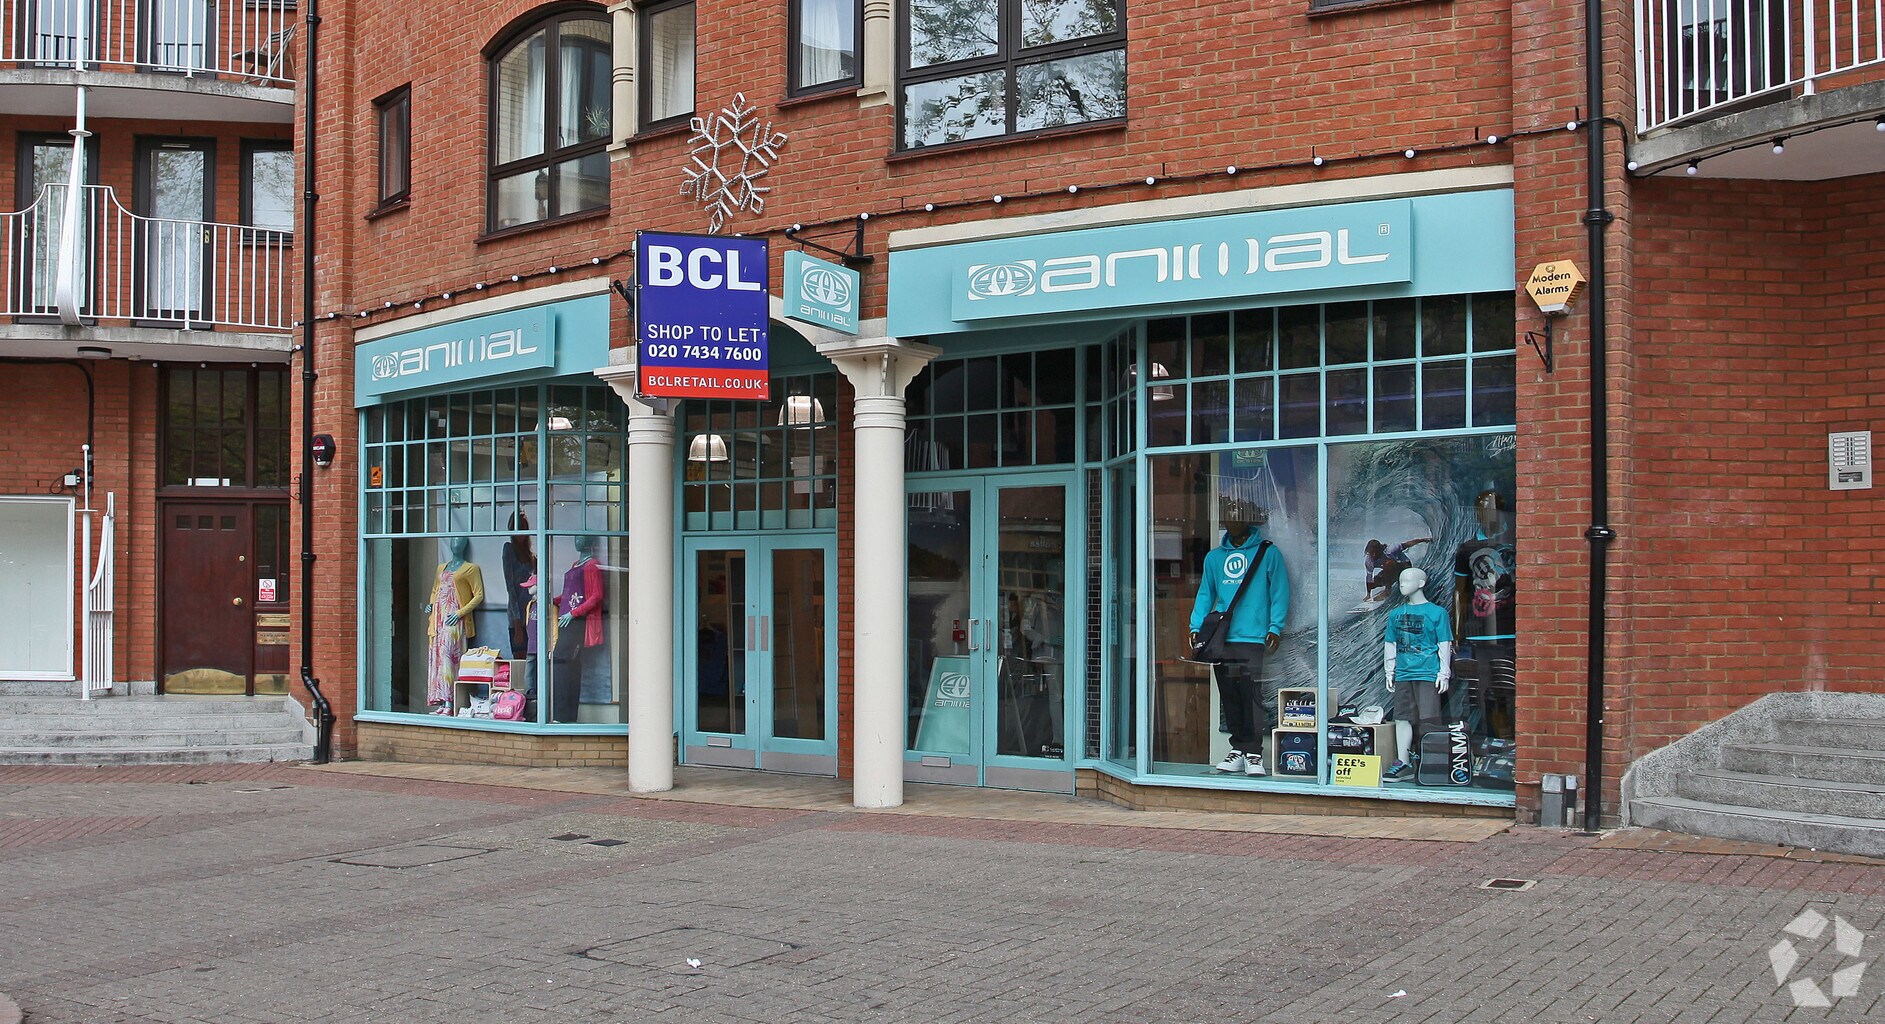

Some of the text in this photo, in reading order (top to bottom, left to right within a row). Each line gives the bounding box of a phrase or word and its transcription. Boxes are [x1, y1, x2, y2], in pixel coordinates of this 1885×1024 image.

[648, 245, 761, 291] BCL
[1532, 272, 1571, 283] Modern
[1535, 285, 1569, 296] Alarms
[647, 323, 761, 343] SHOP TO LET
[648, 344, 762, 361] 020 7434 7600
[648, 375, 762, 389] BCLRETAIL.CO.UK
[934, 699, 970, 708] anima
[1335, 767, 1352, 776] off
